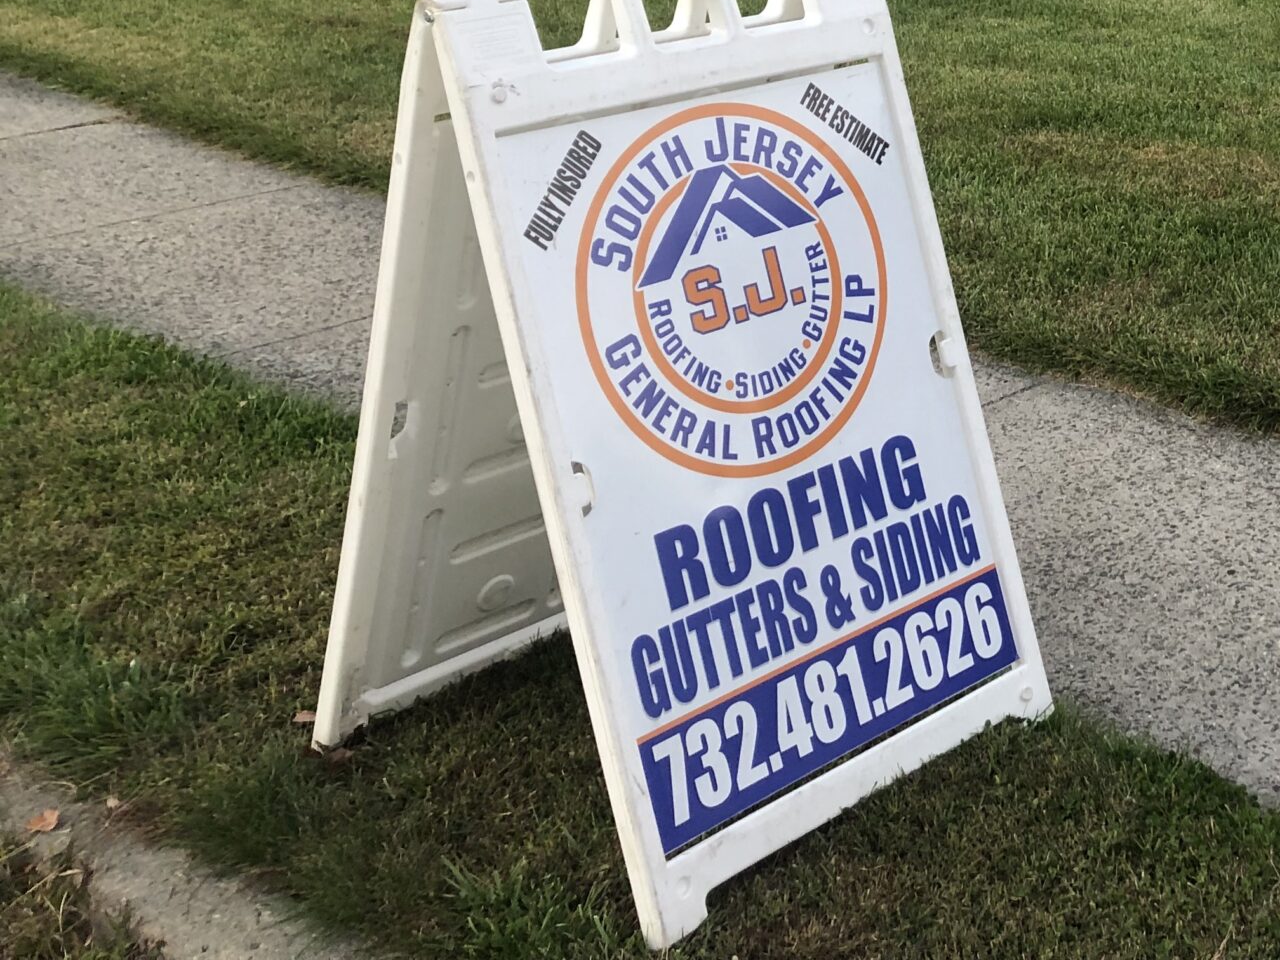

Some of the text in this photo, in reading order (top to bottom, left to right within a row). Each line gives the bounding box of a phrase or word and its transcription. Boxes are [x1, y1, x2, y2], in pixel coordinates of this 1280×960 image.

[523, 129, 602, 252] FULLY INSURED
[591, 117, 844, 273] SOUTH JERSEY
[800, 82, 890, 166] FREE ESTIMATE
[605, 274, 876, 461] GENERAL ROOFING LP
[648, 241, 830, 399] ROOFING SIDING GUTTER
[681, 245, 807, 335] S.J.
[653, 434, 927, 612] ROOFING
[631, 494, 981, 720] GUTTERS & SIDING
[652, 581, 1003, 828] 732.481.2626
